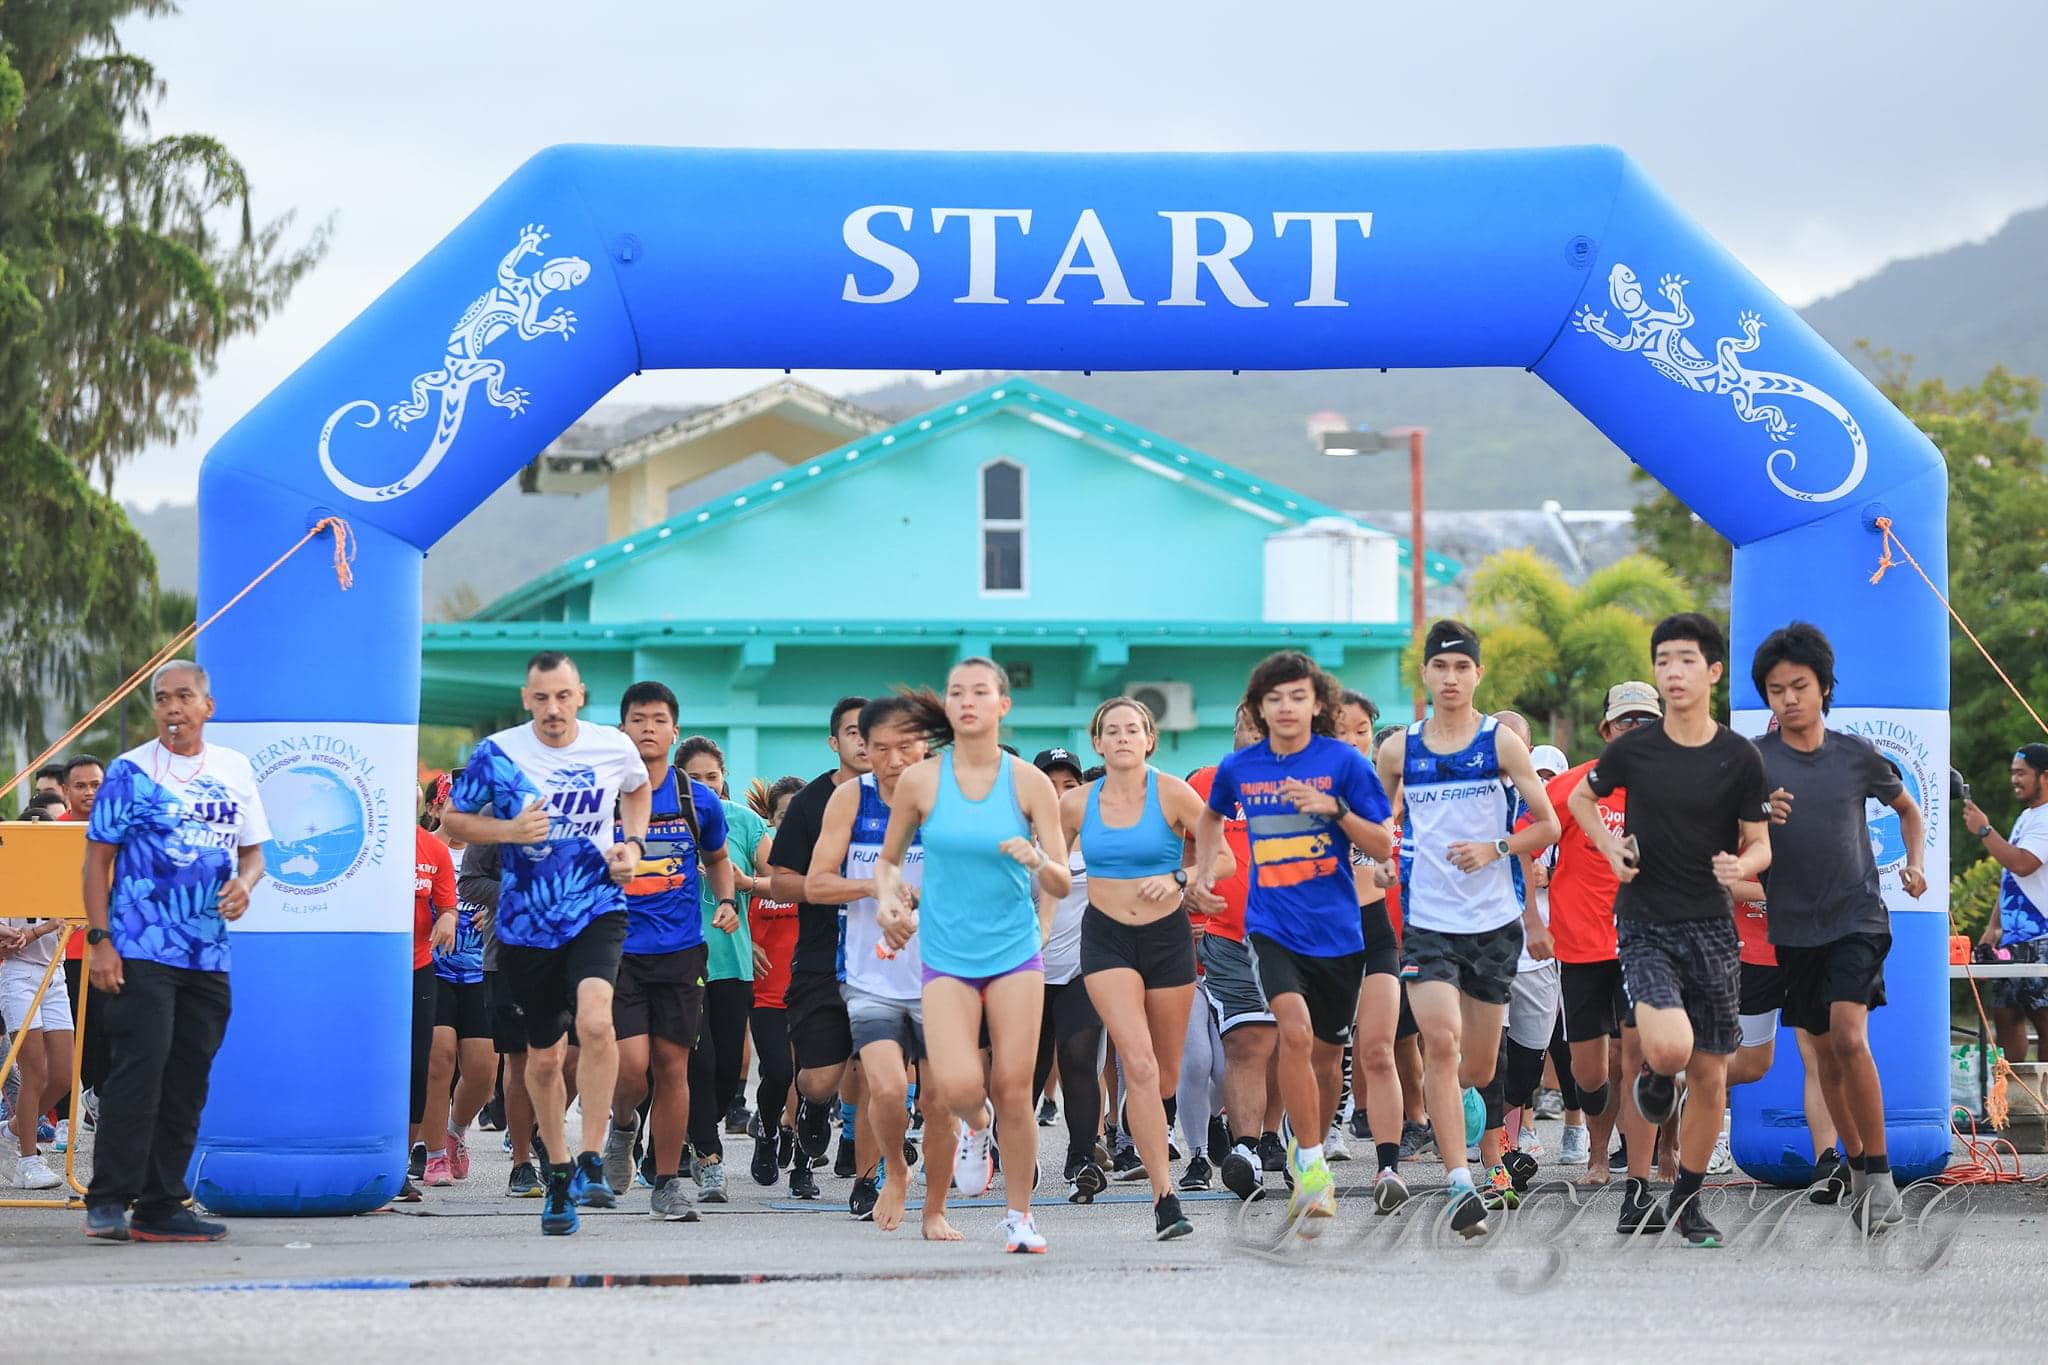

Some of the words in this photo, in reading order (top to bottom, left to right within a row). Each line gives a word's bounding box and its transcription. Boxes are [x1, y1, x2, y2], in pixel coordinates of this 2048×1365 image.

[842, 204, 1374, 308] START
[1874, 738, 1910, 757] INTEGRITY
[256, 754, 302, 784] LEADERSHIP
[311, 753, 351, 772] INTEGRITY
[1441, 784, 1498, 801] SAIPAN
[1844, 719, 1929, 766] NATIONAL
[1925, 771, 1940, 848] SCHOOL
[249, 734, 377, 783] TERNATIONAL
[367, 786, 389, 868] SCHOOL
[271, 880, 338, 896] RESPONSIBILITY
